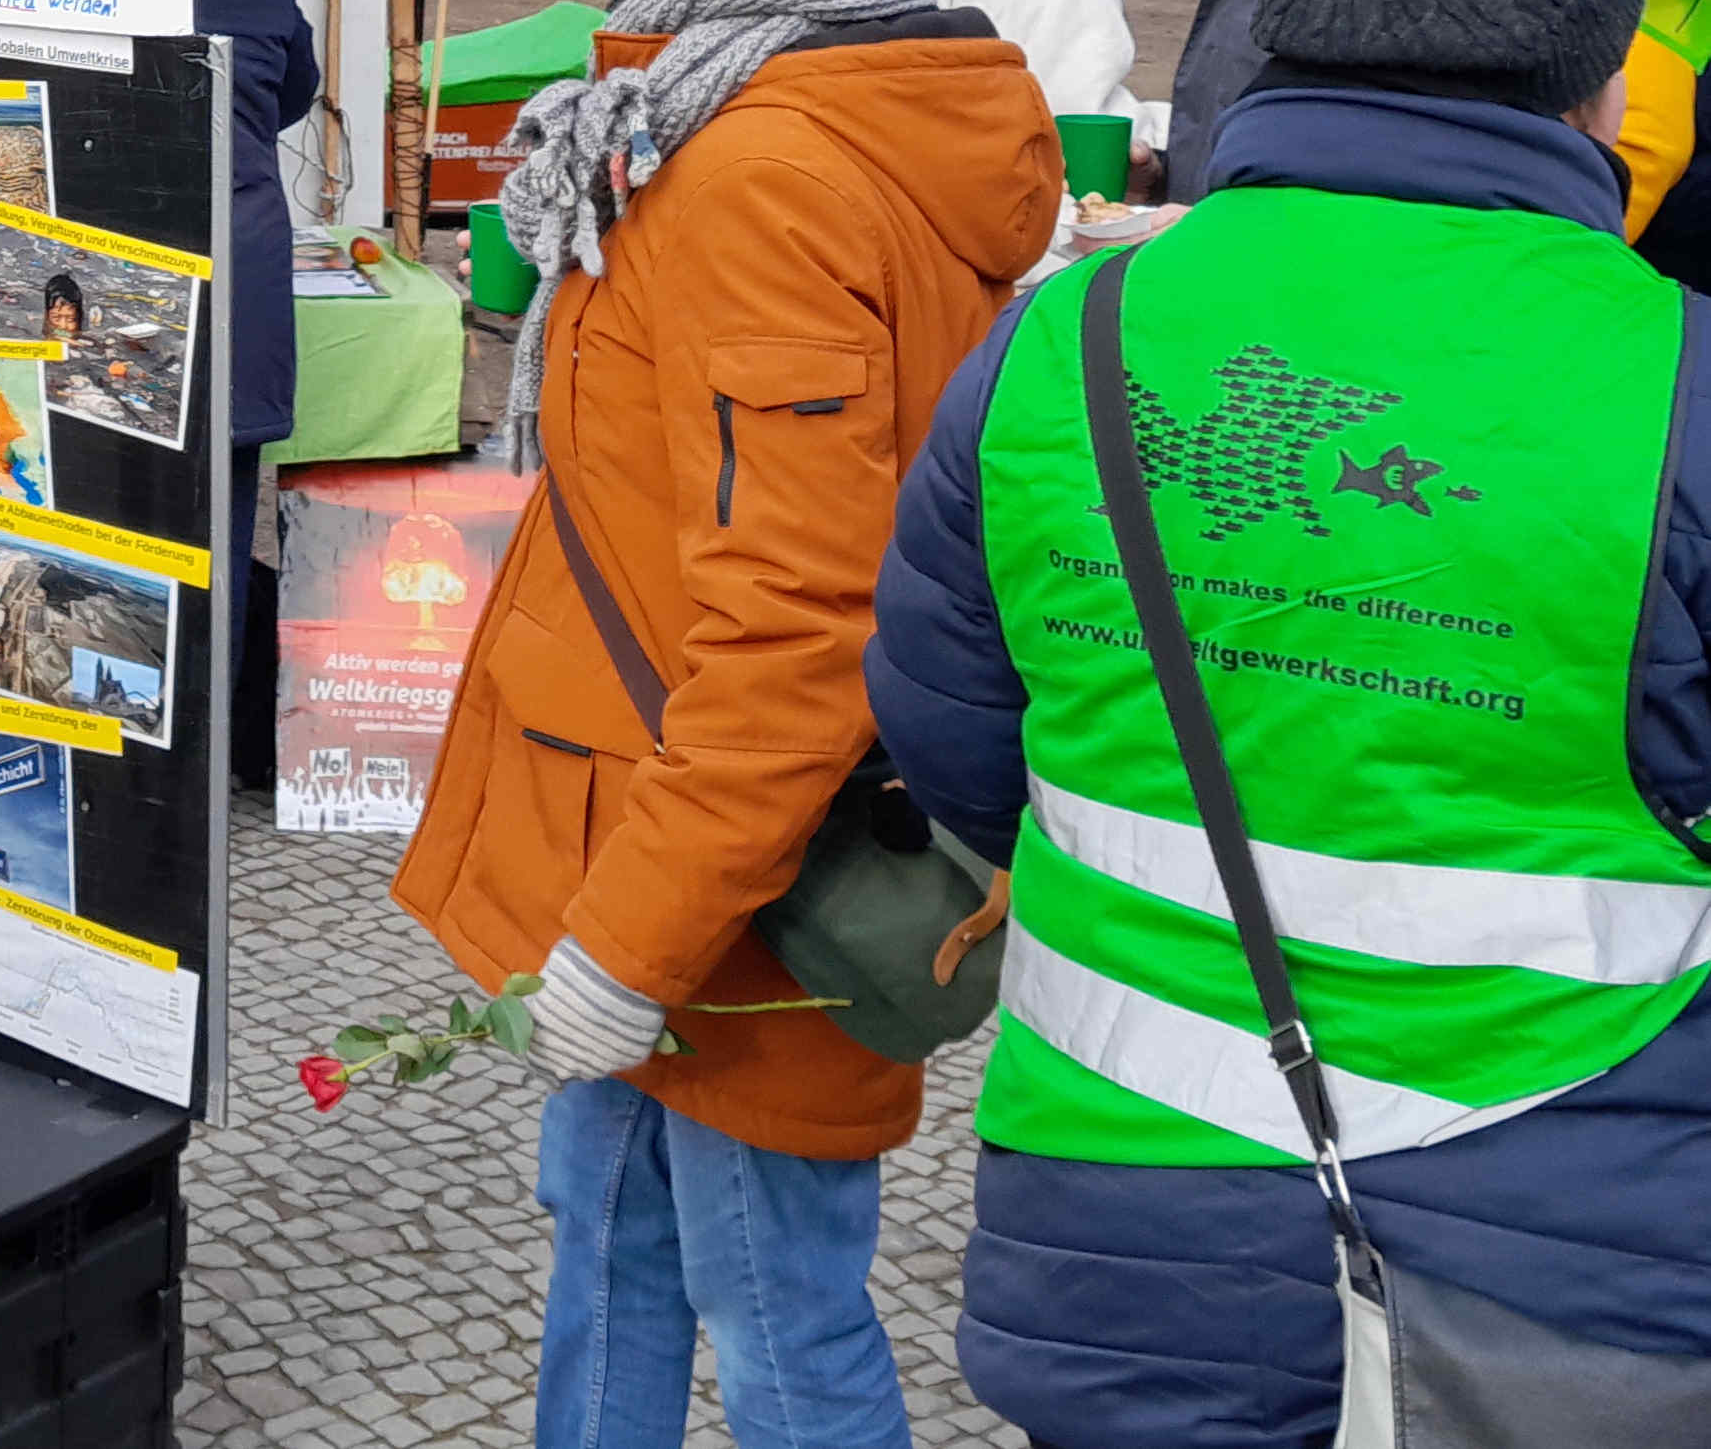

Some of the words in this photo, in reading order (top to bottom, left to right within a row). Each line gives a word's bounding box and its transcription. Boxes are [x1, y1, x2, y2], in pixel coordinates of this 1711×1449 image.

[47, 46, 130, 69] Umweltkrise
[86, 234, 107, 247] und
[110, 239, 197, 273] Verschmutzung
[114, 532, 133, 547] der
[1203, 572, 1287, 603] makes
[1304, 588, 1346, 611] the
[1357, 596, 1514, 639] difference
[323, 653, 373, 671] Aktiv
[308, 677, 454, 711] Weltkriegsg
[313, 750, 349, 774] No!
[64, 920, 82, 936] der
